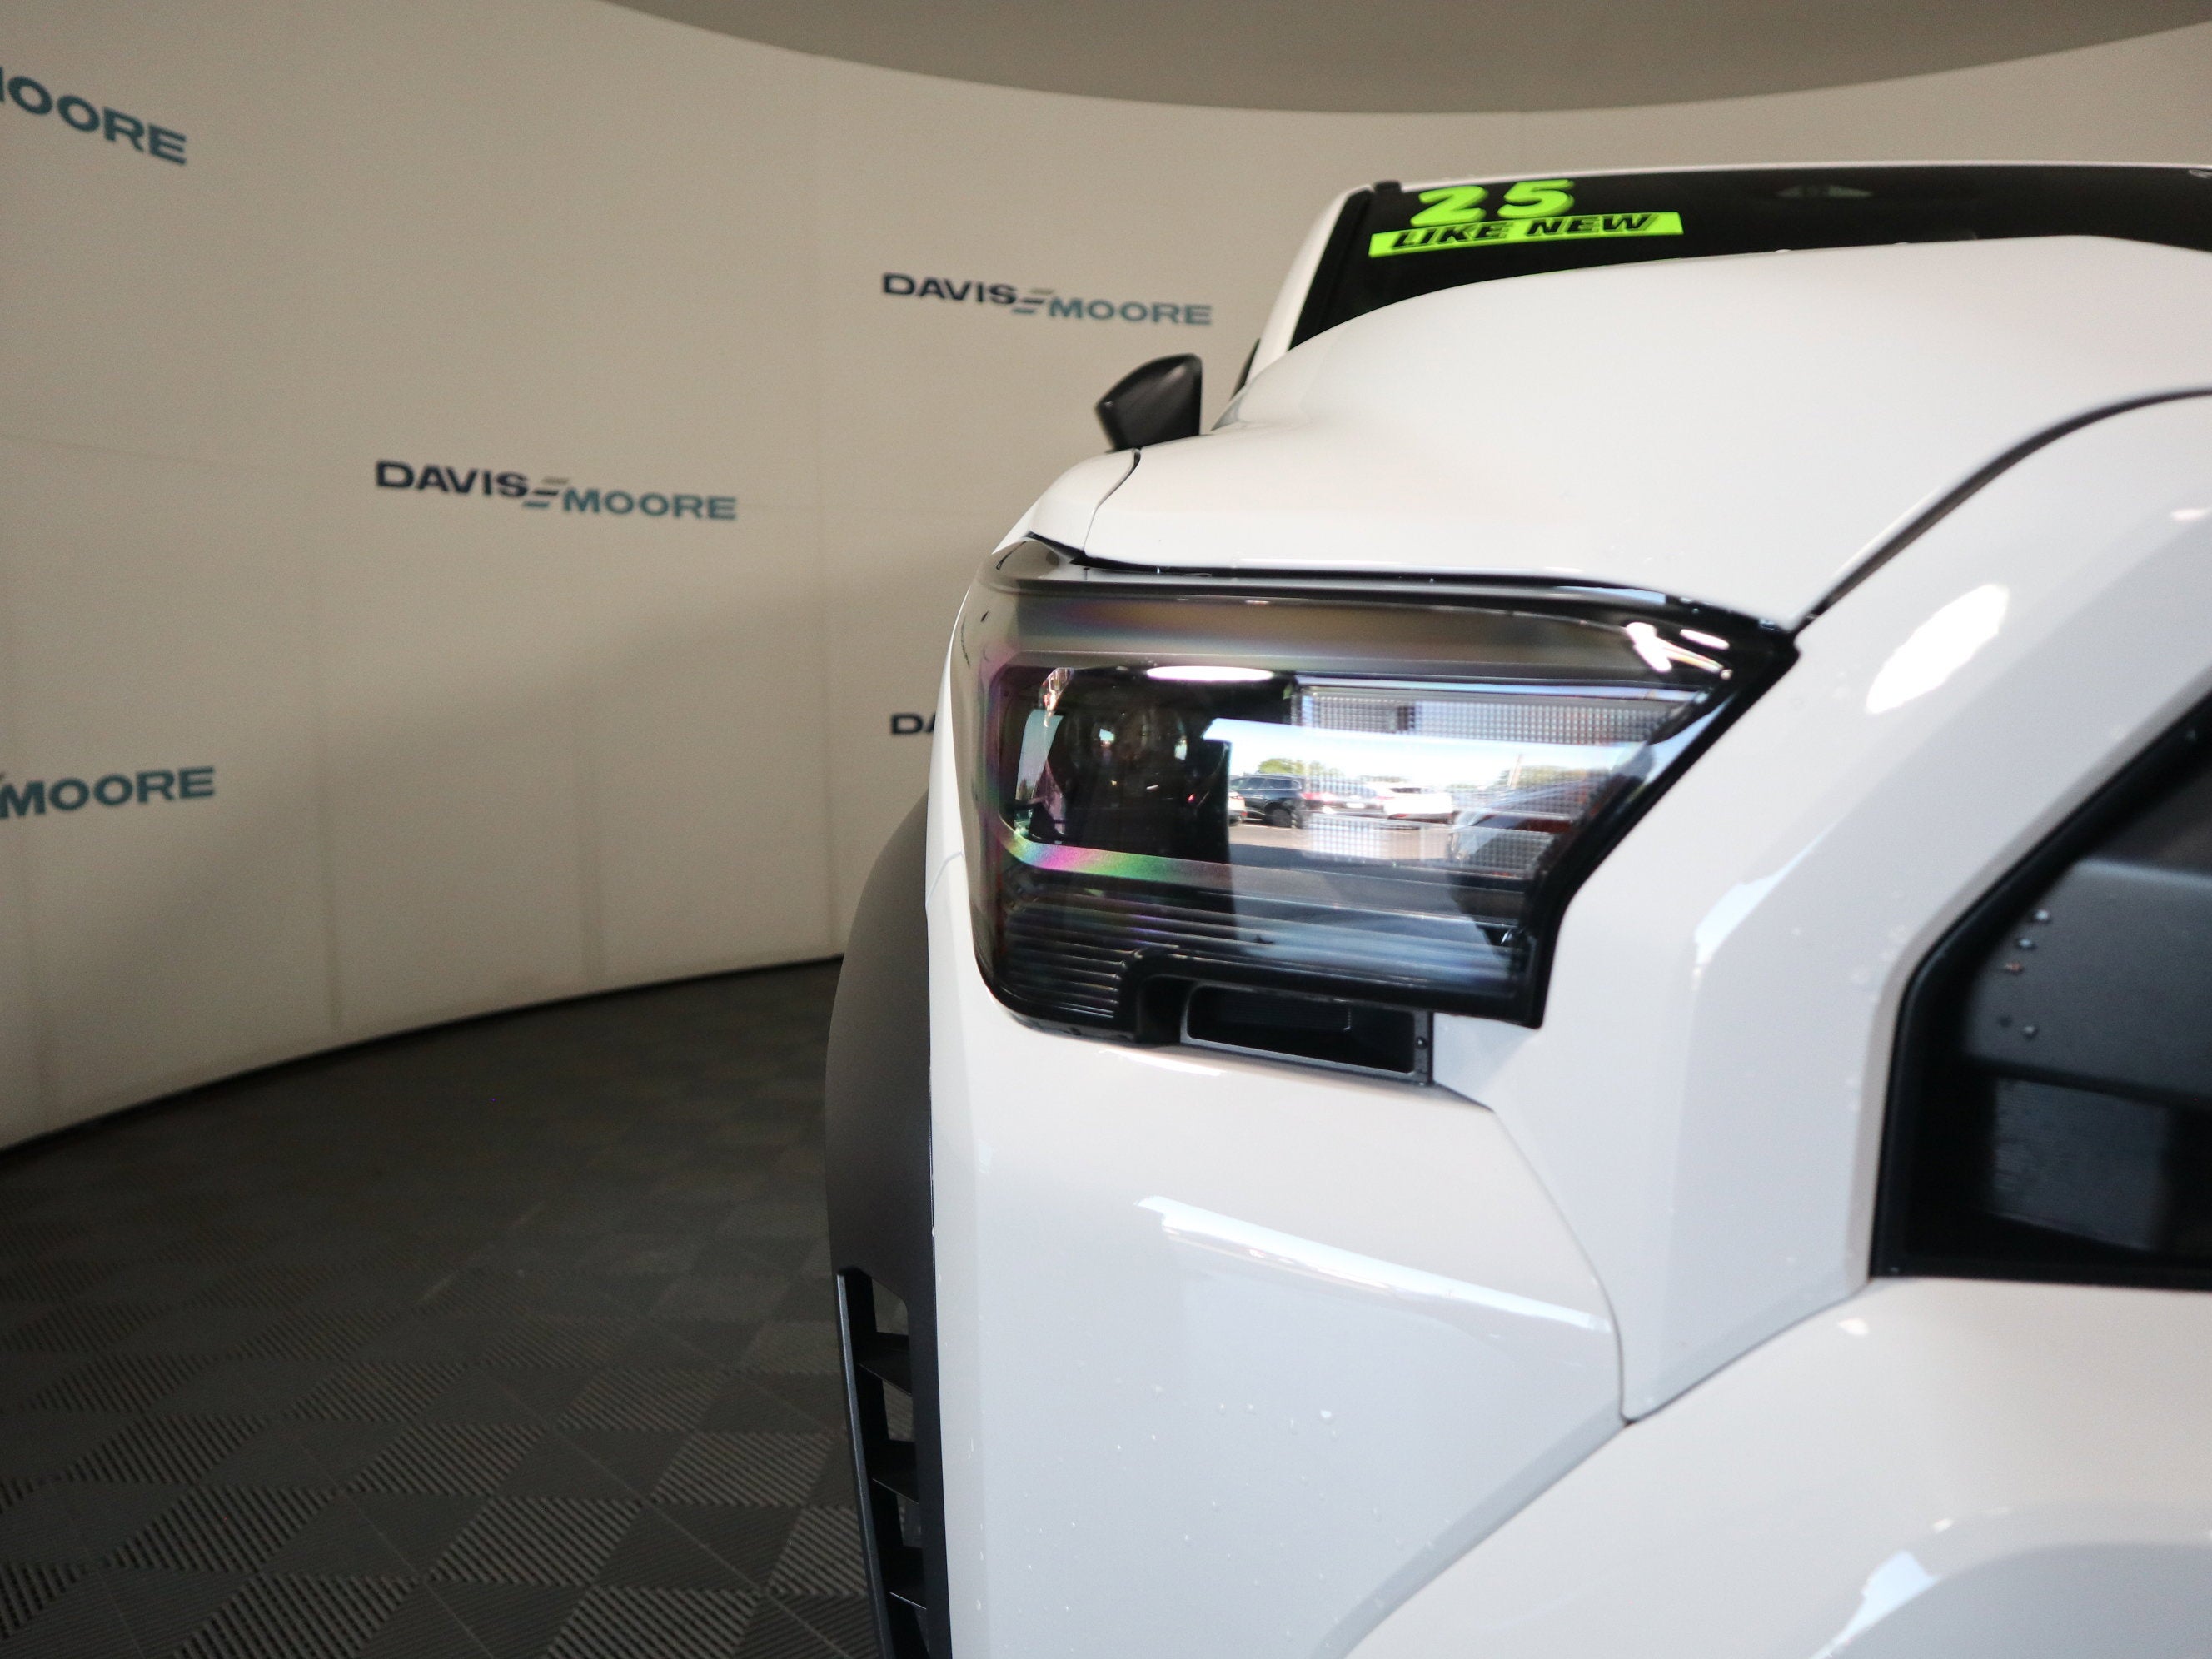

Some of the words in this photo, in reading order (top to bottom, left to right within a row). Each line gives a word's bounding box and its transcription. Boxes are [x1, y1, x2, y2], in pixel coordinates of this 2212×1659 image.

[0, 67, 187, 165] OORE
[1410, 178, 1574, 227] 25
[1391, 222, 1511, 249] LIKE
[1526, 212, 1657, 236] NEW
[882, 272, 1018, 306] DAVIS
[1049, 297, 1213, 325] MOORE
[376, 460, 529, 498] DAVIS
[562, 488, 737, 521] MOORE
[0, 766, 215, 819] MOORE
